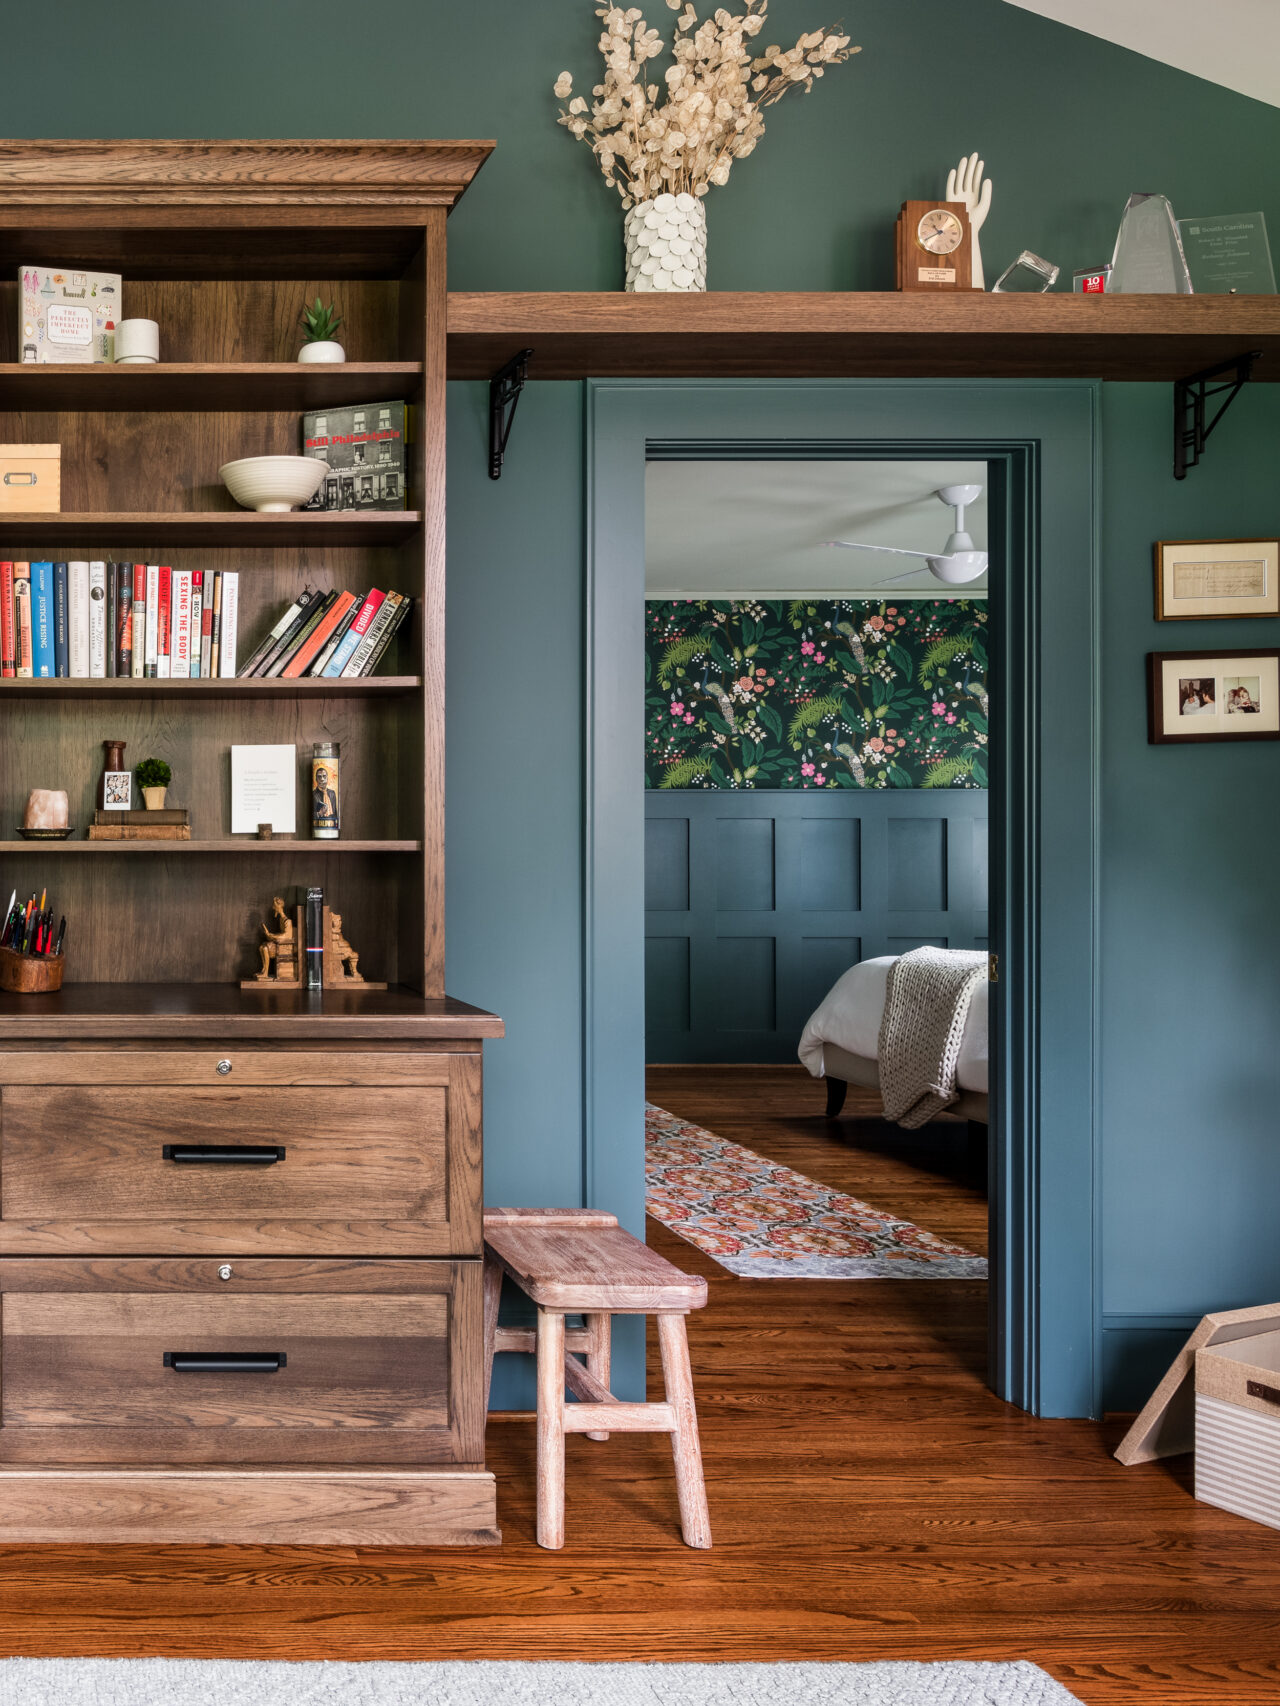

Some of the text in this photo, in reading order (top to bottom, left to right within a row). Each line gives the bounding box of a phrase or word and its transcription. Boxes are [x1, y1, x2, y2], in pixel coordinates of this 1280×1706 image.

[1087, 276, 1100, 285] 10
[306, 429, 400, 448] Still Philadelphia
[38, 595, 48, 649] JUSTICE RISING
[179, 576, 188, 660] SEXING THE BODY
[356, 603, 374, 632] DIVIDED
[334, 643, 352, 665] STAND
